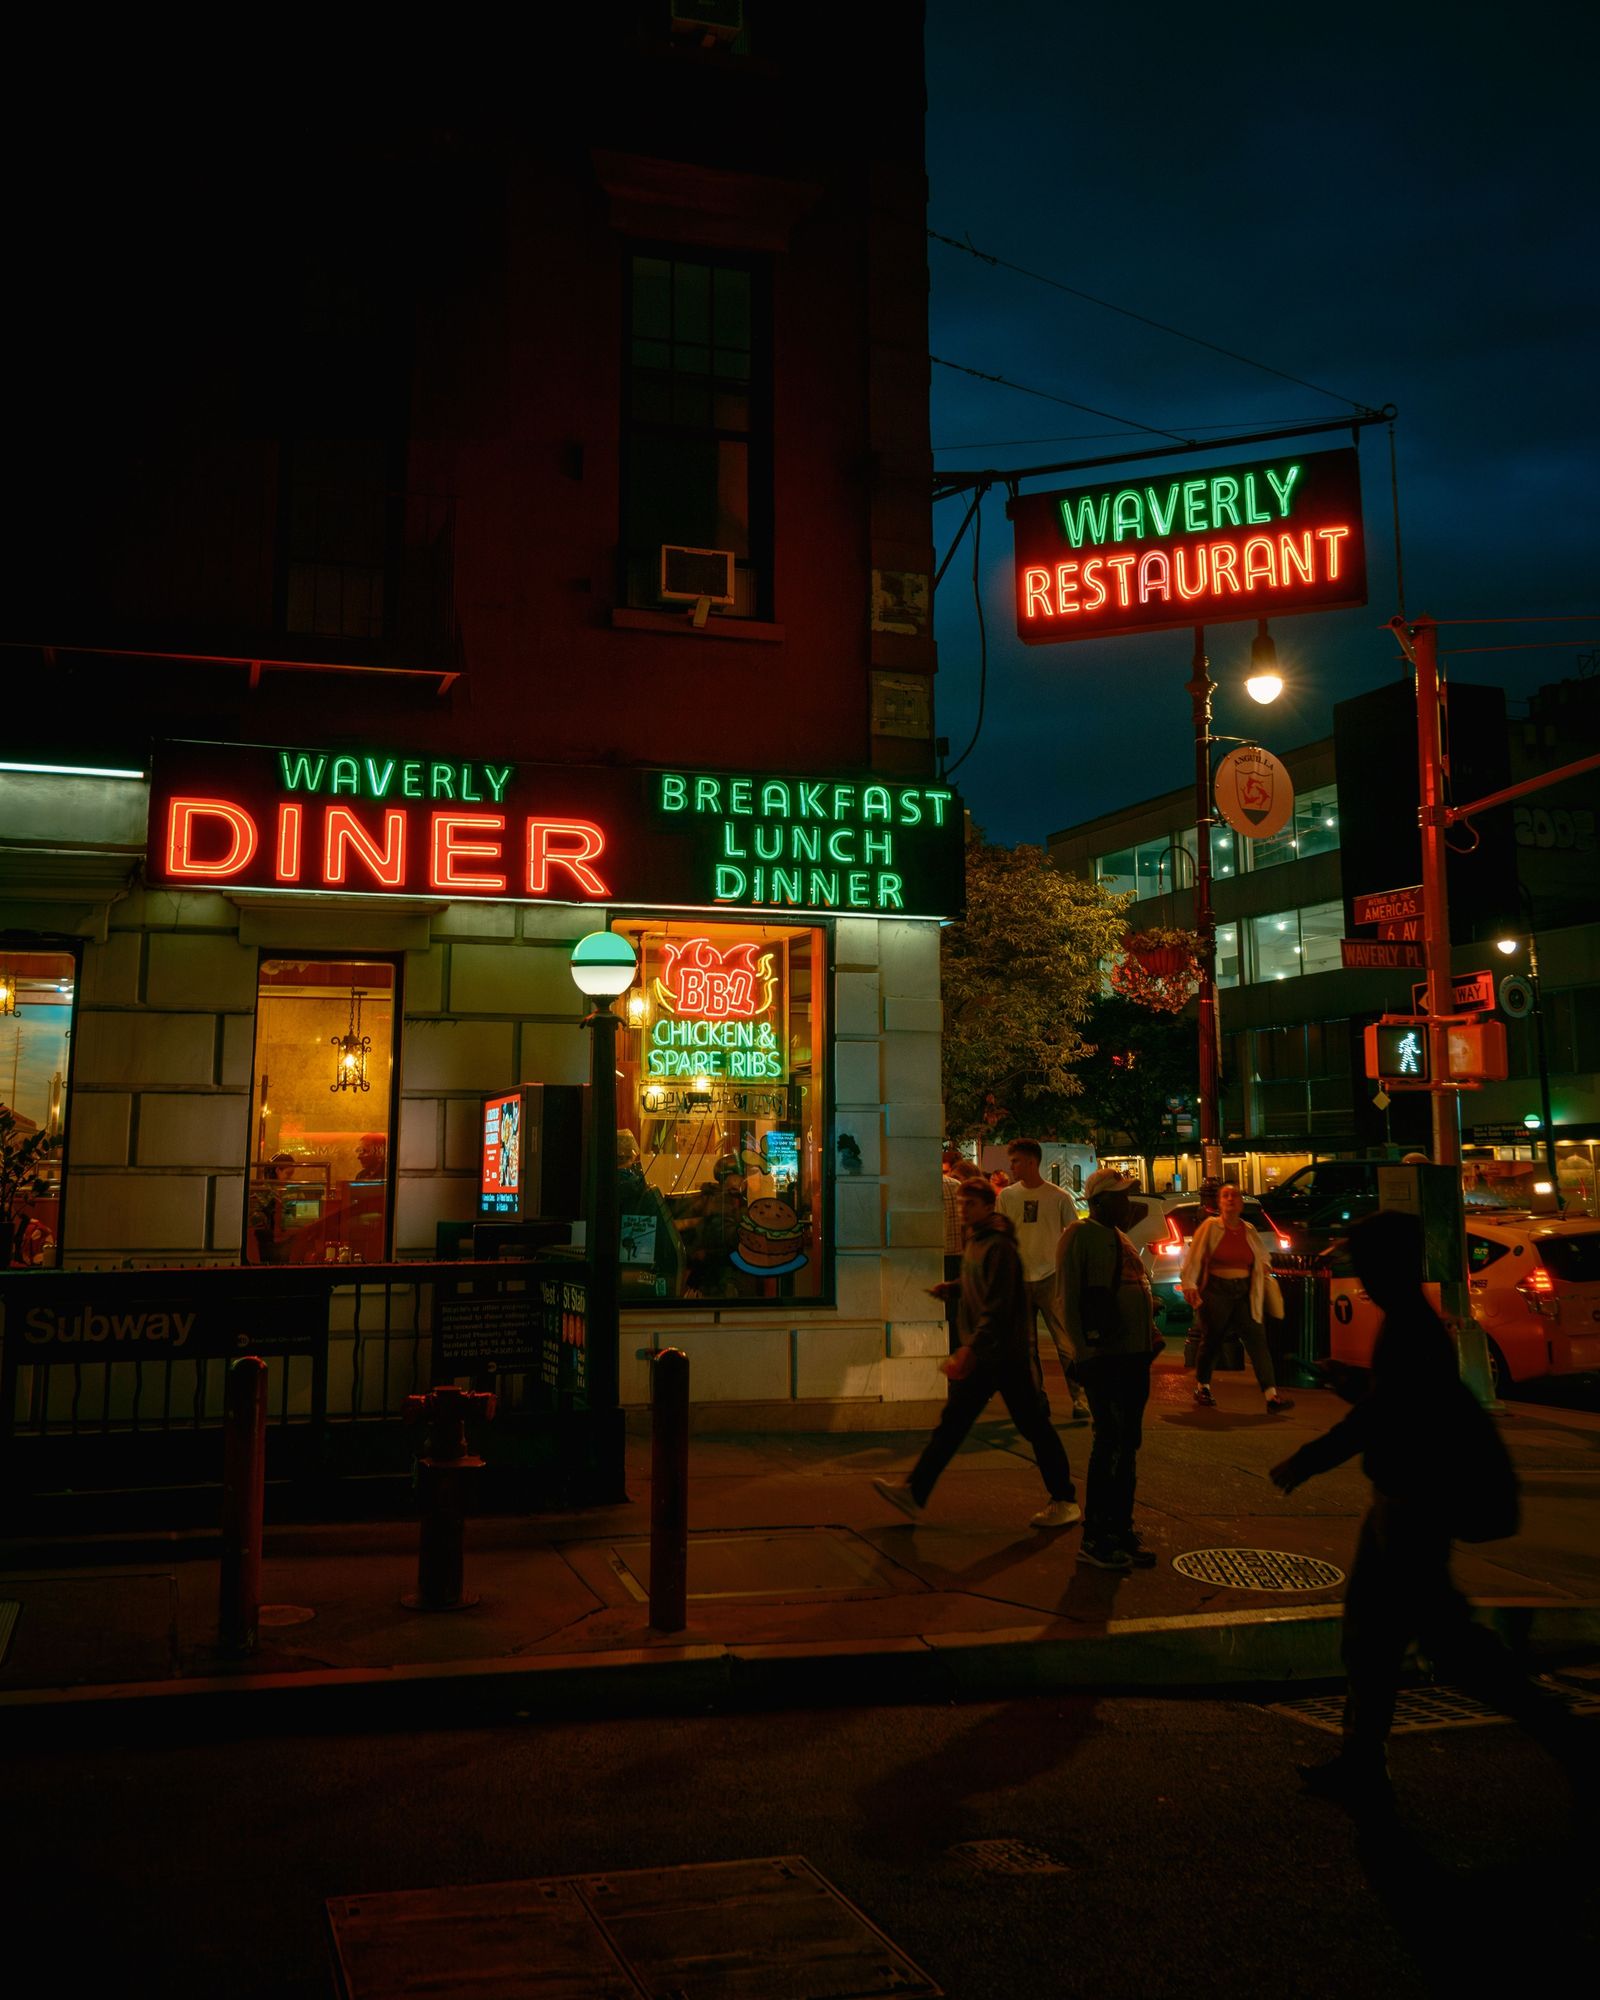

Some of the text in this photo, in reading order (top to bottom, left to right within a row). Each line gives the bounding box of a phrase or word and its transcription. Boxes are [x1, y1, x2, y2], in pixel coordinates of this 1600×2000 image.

[1061, 465, 1301, 549] WAVERLY
[1023, 527, 1350, 618] RESTAURANT
[279, 752, 513, 802] WAVERLY
[1234, 754, 1273, 771] ANGUILLA
[661, 774, 952, 827] BREAKFAST
[165, 797, 612, 896] DINER
[724, 821, 893, 866] LUNCH
[715, 864, 904, 909] DINNER
[1365, 900, 1417, 920] AMERICAS
[1387, 920, 1417, 940] 6 AV
[1344, 946, 1422, 966] WAVERLY PL
[678, 968, 756, 1017] BBQ
[1457, 984, 1481, 1001] WAY
[653, 1019, 754, 1048] CHICKEN
[648, 1049, 782, 1078] SPARE RIBS
[24, 1304, 197, 1347] Subway
